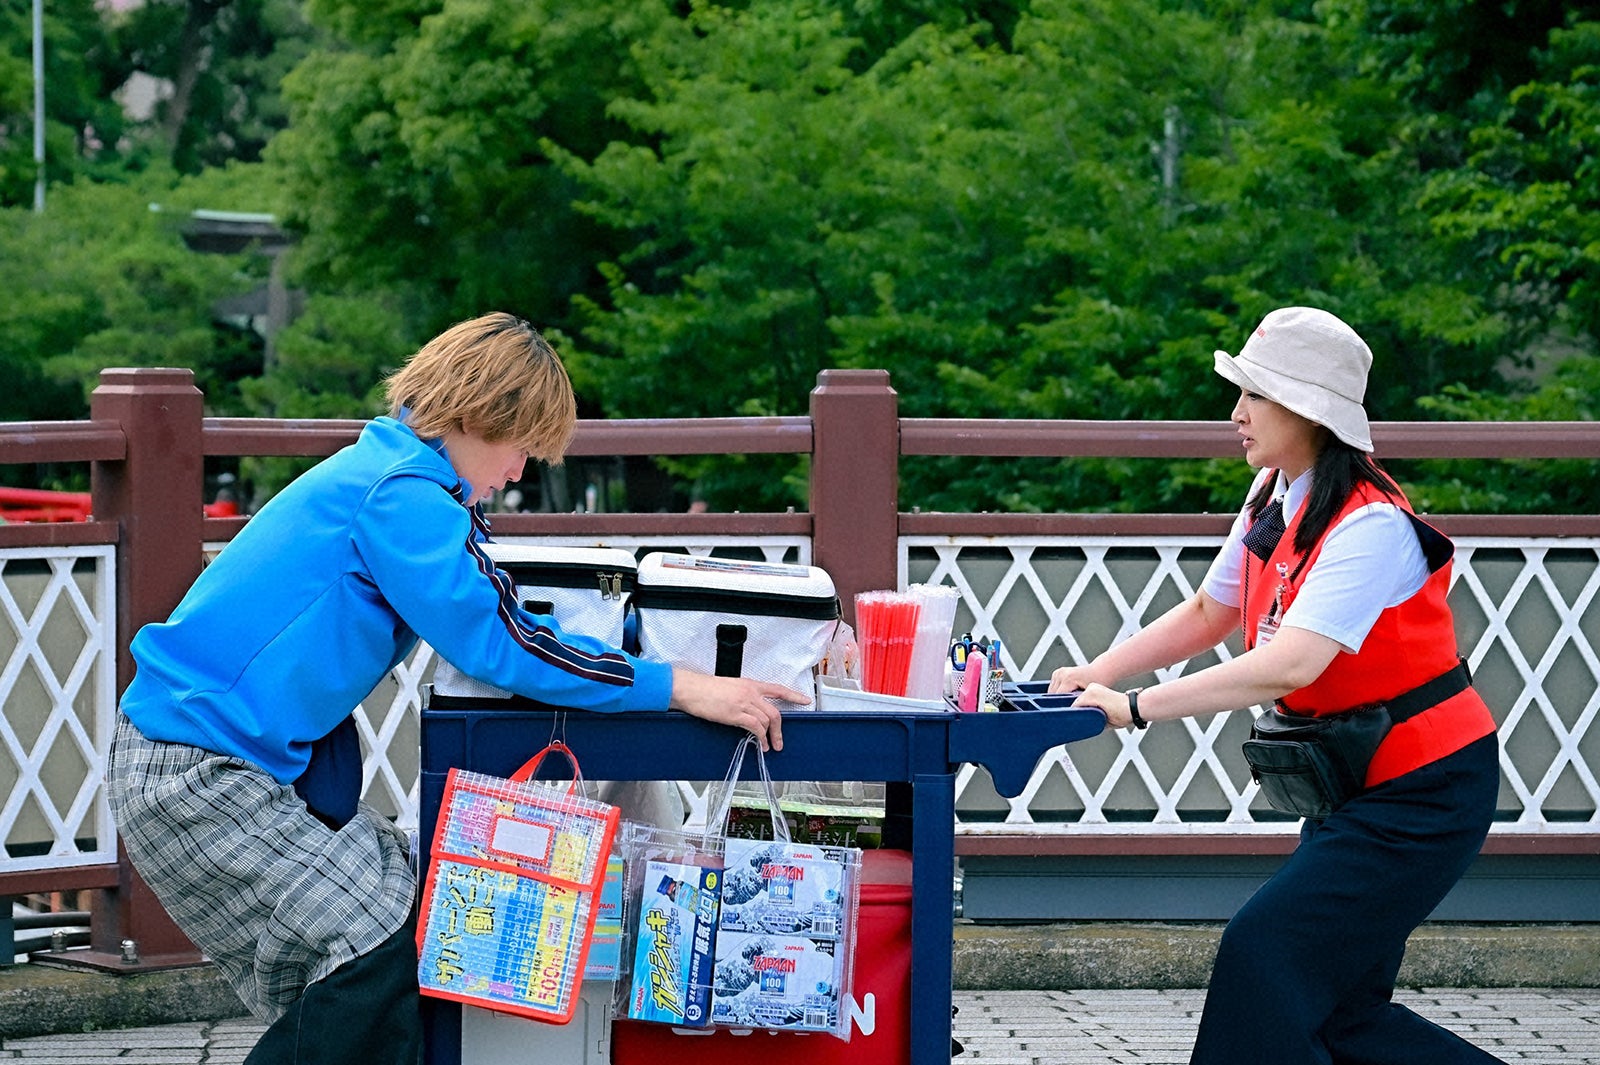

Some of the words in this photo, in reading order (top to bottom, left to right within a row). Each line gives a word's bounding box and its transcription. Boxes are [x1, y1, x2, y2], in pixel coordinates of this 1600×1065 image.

[761, 863, 804, 881] ZAPAAN
[774, 885, 789, 896] 100
[694, 887, 715, 955] 眠気ゼロ!
[646, 909, 684, 1017] ガンシャキ
[753, 955, 796, 973] ZAPAAN
[766, 977, 781, 988] 100
[635, 987, 644, 1012] ZAPAAN
